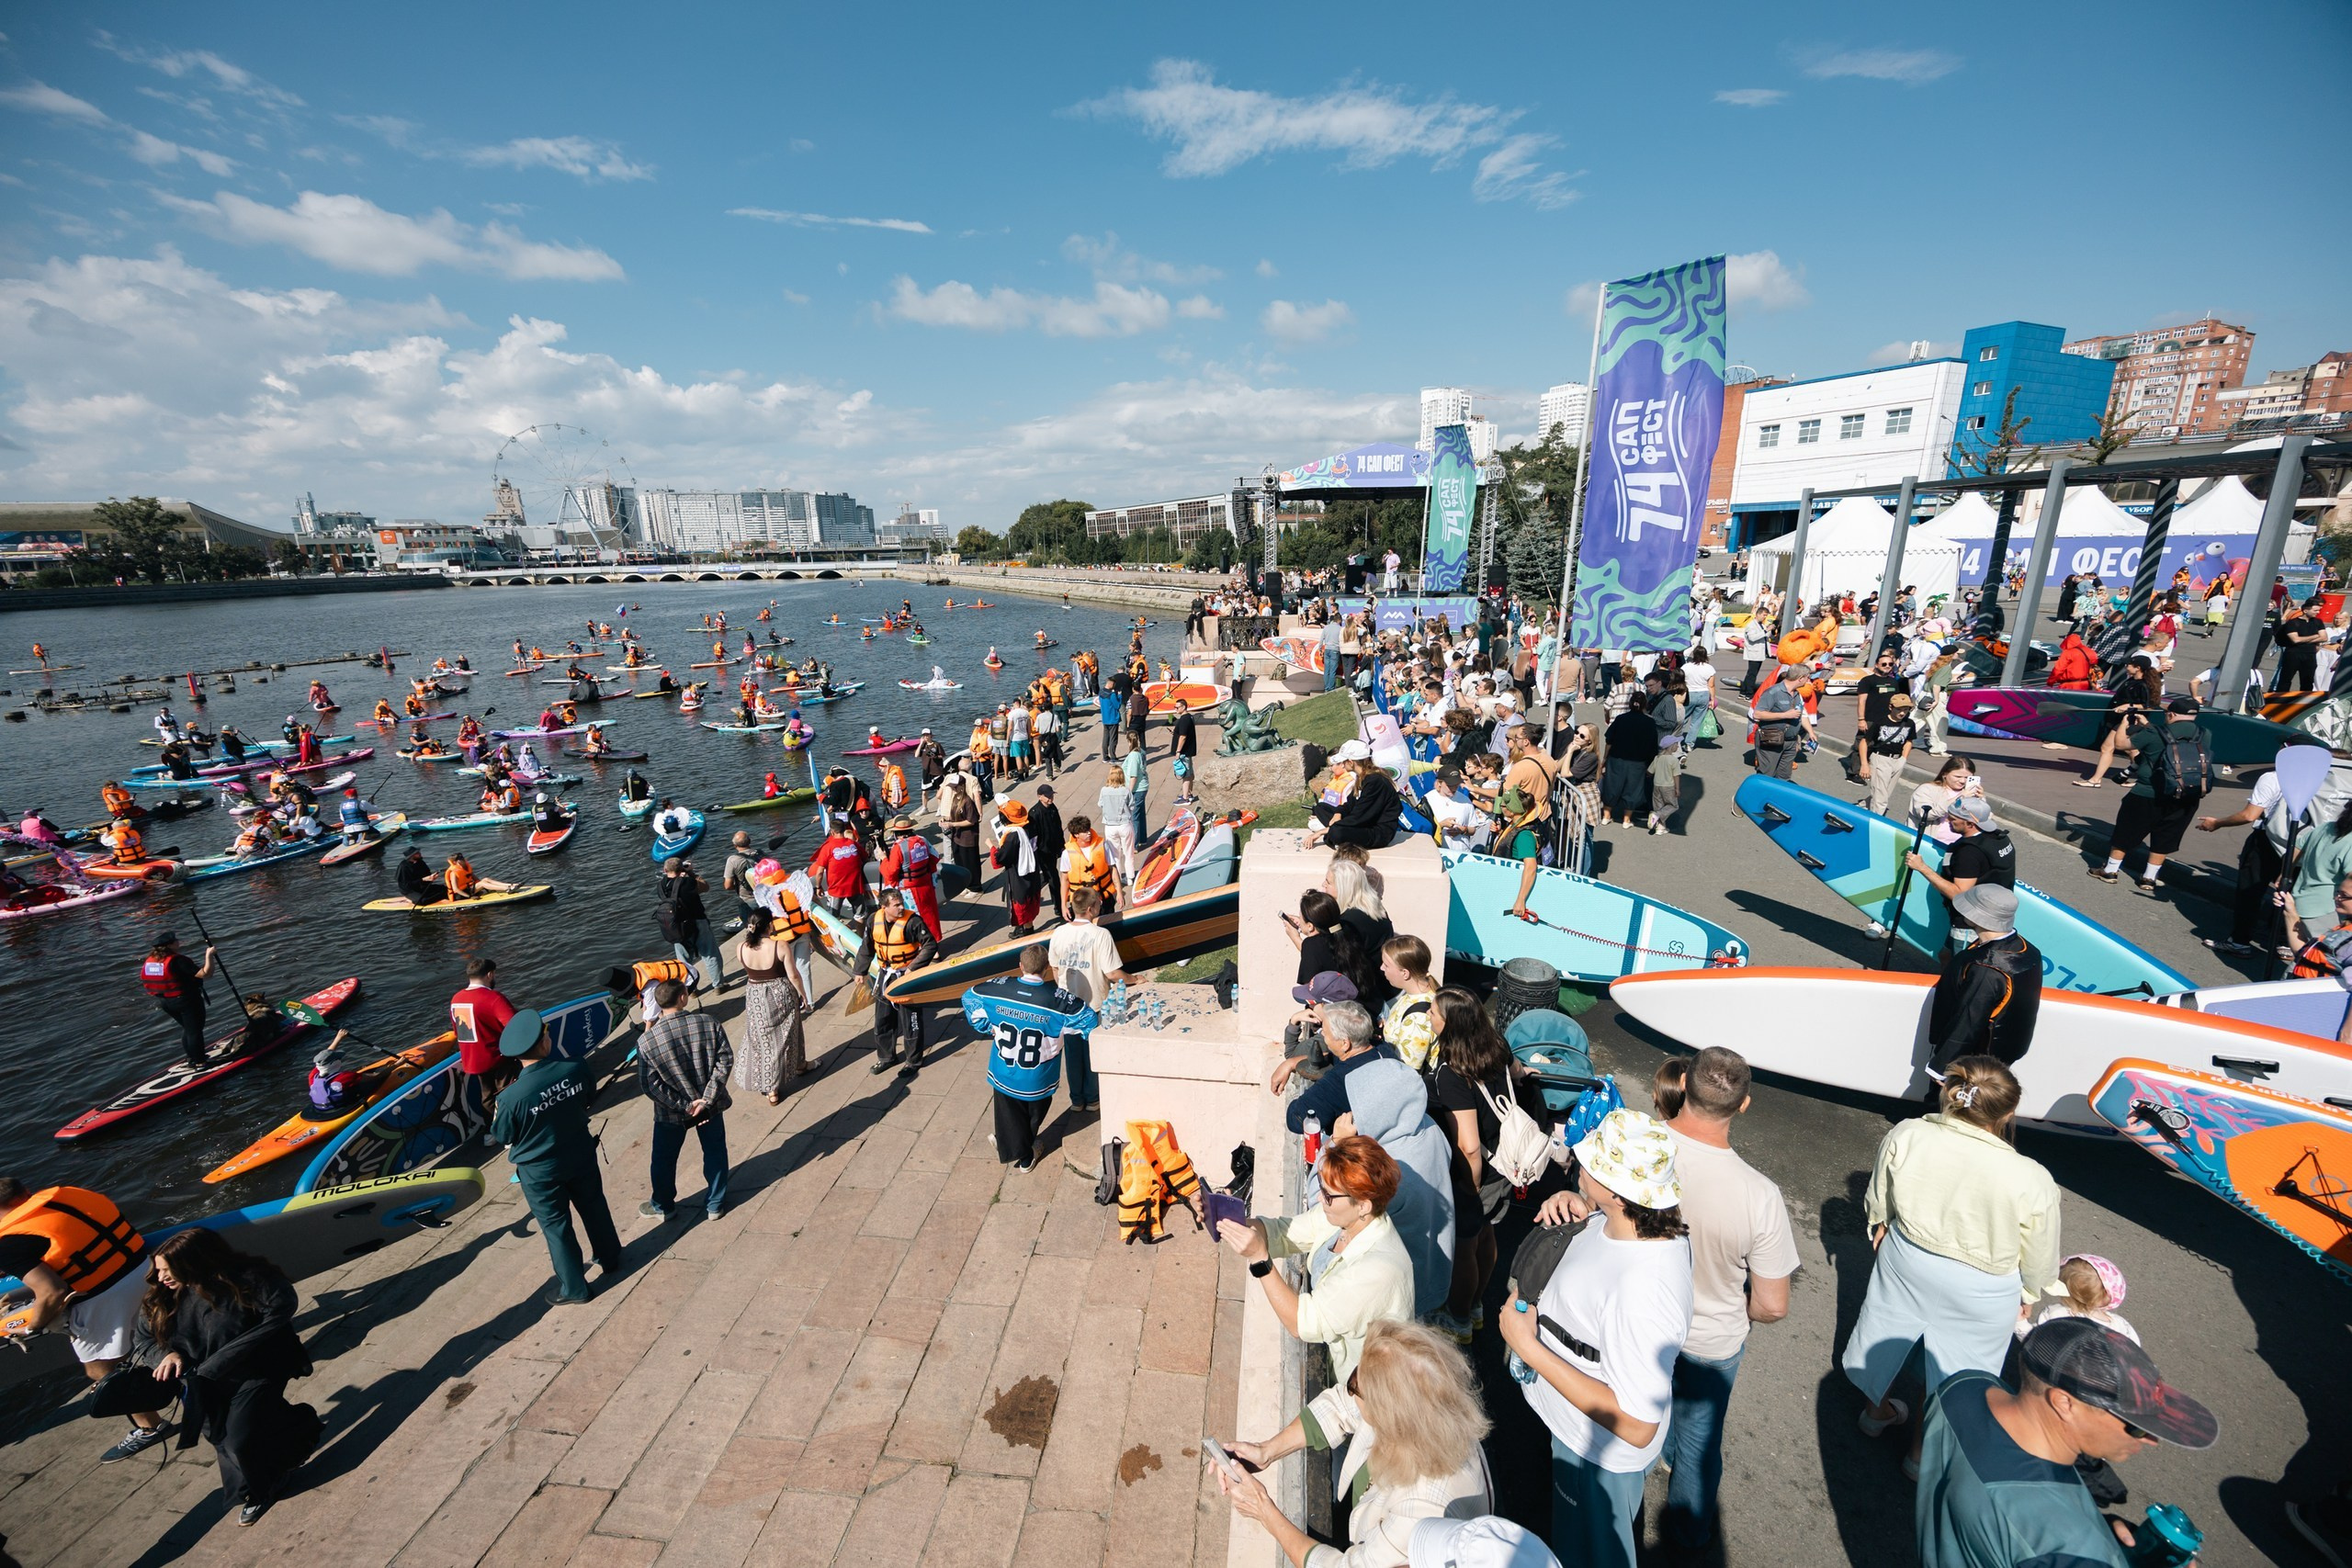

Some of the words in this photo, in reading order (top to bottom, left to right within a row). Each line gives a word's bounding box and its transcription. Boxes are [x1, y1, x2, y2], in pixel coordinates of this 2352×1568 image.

[1616, 400, 1644, 466] САП
[1641, 399, 1667, 465] ФЕСТ
[1356, 455, 1366, 473] 74
[1367, 455, 1383, 472] САП
[1383, 454, 1405, 472] ФЕСТ
[1441, 478, 1452, 508] САП
[1624, 471, 1683, 542] 74
[1444, 510, 1464, 541] 74
[996, 1004, 1051, 1024] SHUKHOVTCEV
[997, 1021, 1045, 1069] 28
[529, 1082, 583, 1115] РОССИИ
[539, 1078, 571, 1101] МЧС
[312, 1170, 436, 1200] MOLOKAI
